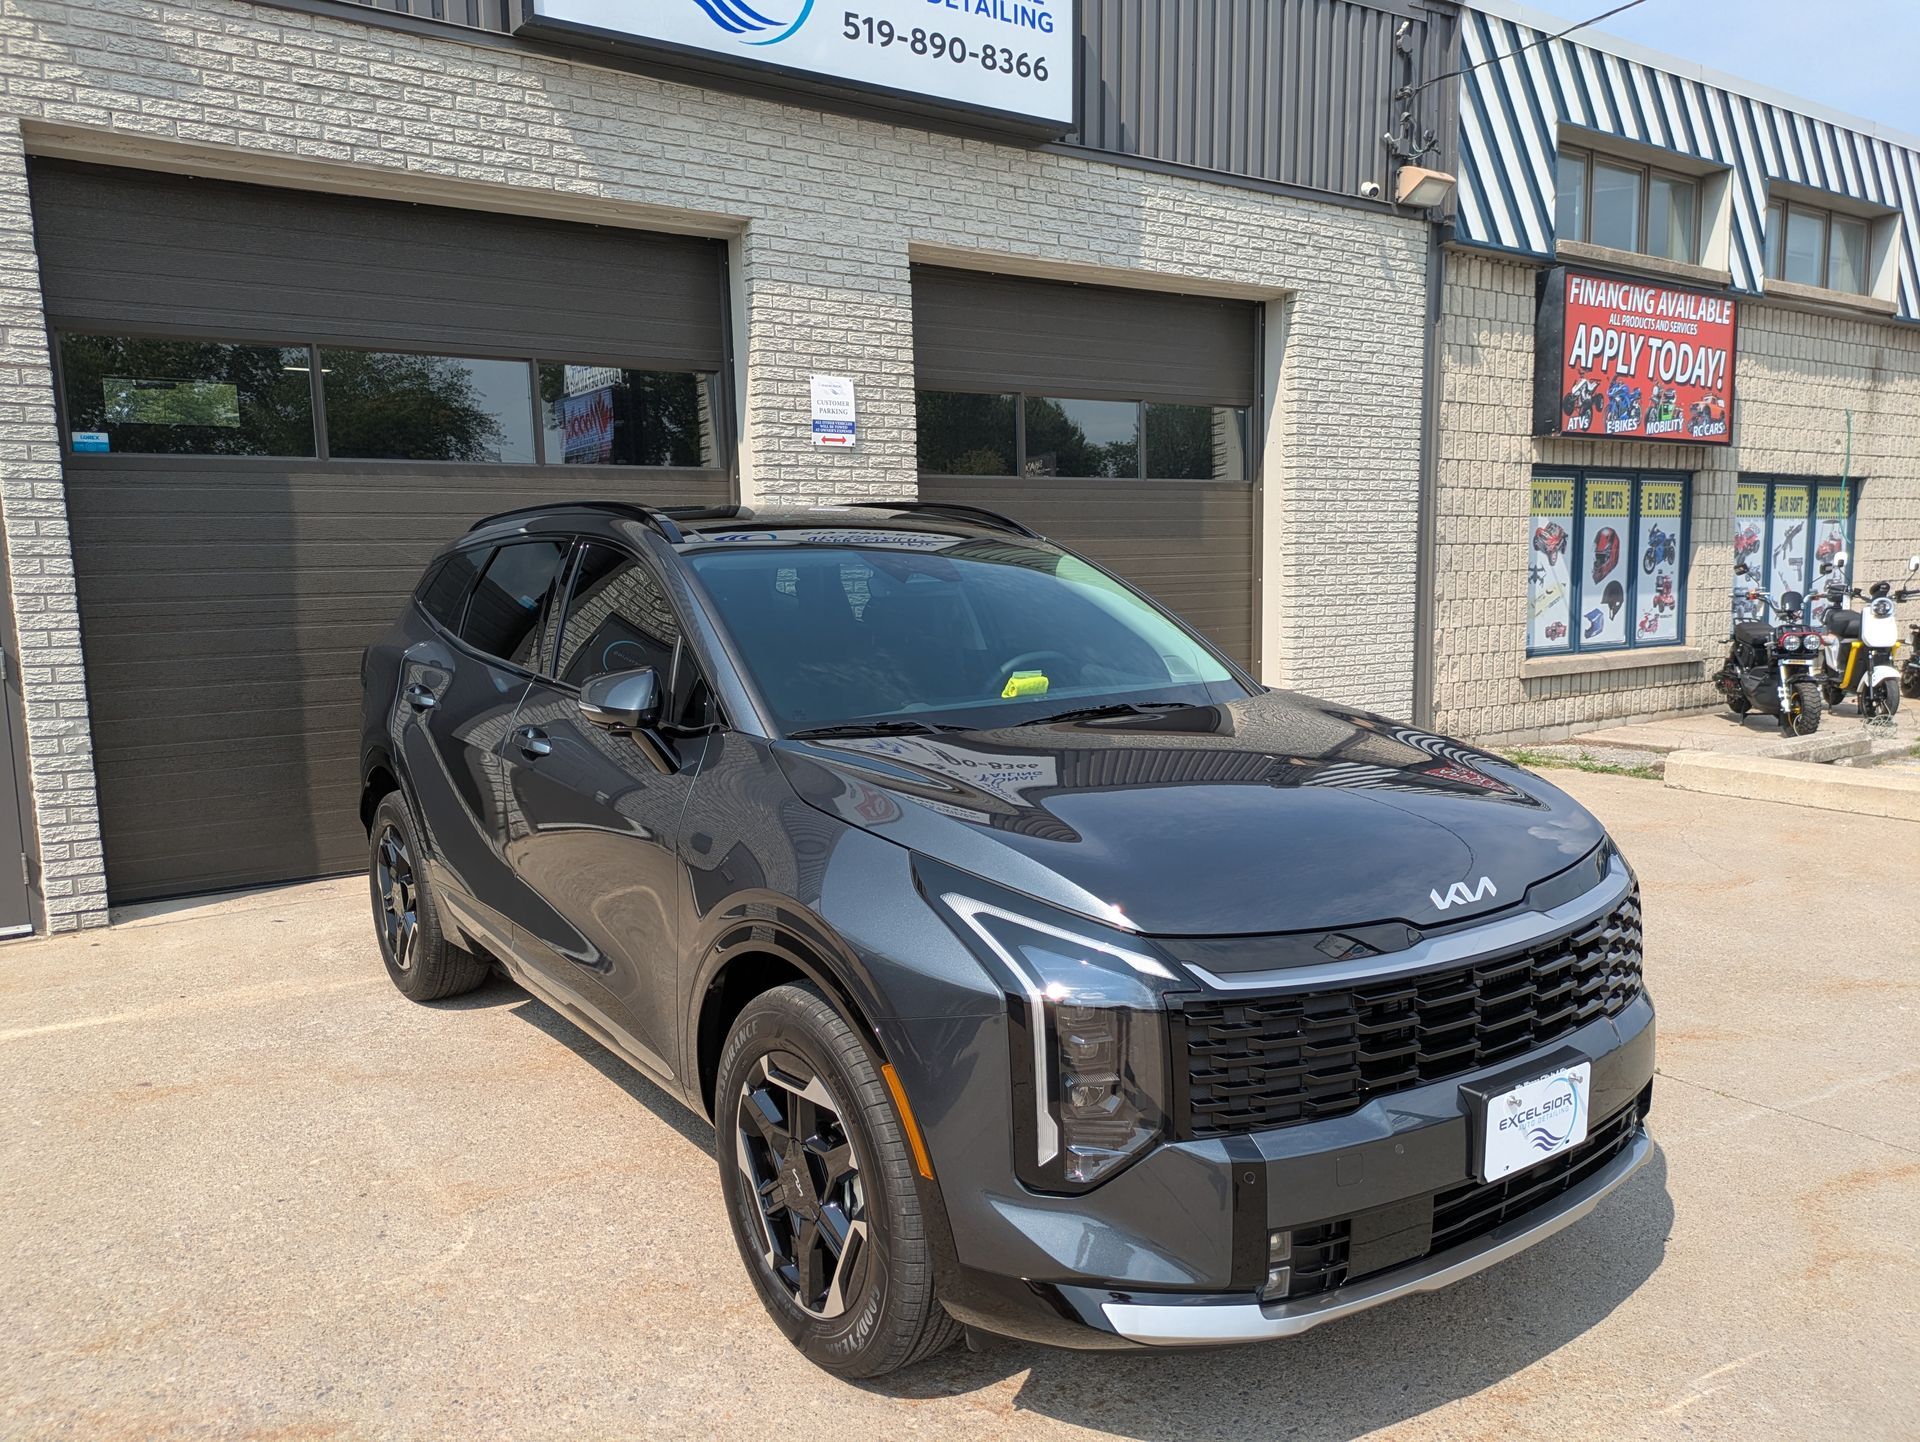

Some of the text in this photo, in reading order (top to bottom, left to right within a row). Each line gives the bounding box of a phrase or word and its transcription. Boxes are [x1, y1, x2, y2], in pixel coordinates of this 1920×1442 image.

[842, 11, 1049, 82] 519-890-8366
[1569, 277, 1732, 325] FINANCING AVAILABLE
[1608, 313, 1698, 336] ALL PRODUCTS AND SERVICES
[1569, 324, 1727, 391] APPLY TODAY!
[816, 399, 850, 407] CUSTOMER
[819, 407, 849, 415] PARKING
[1567, 416, 1589, 430] ATVs
[1606, 418, 1638, 434] E-BIKES
[1646, 418, 1684, 435] MOBILITY
[1692, 422, 1724, 438] RC CARS
[1532, 489, 1567, 509] RC HOBBY
[1592, 490, 1623, 510] HELMETS
[1647, 492, 1676, 511] E BIKES
[1737, 493, 1758, 511] ATV's
[1779, 496, 1804, 513] AIR SOFT
[1429, 876, 1498, 911] KIA
[1499, 1093, 1573, 1131] EXCELSIOR
